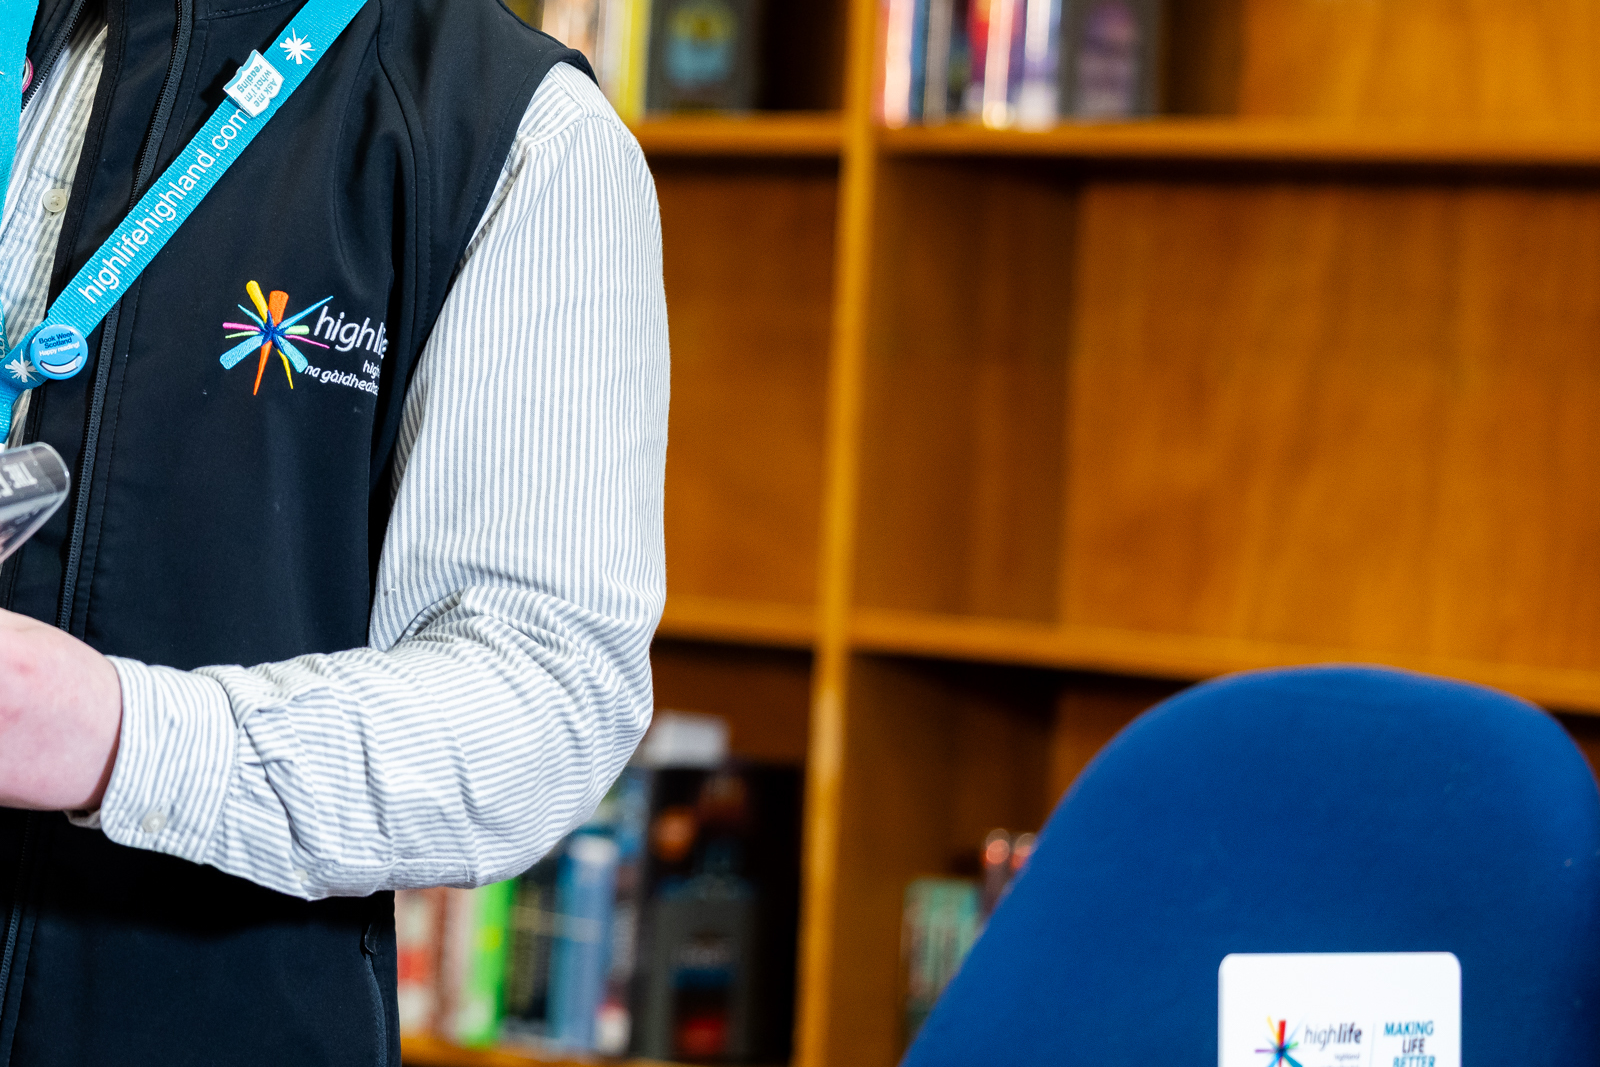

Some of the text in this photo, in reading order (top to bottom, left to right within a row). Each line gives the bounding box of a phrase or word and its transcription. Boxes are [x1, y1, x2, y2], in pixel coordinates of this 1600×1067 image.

[78, 108, 251, 304] highlifehighland.com
[39, 331, 74, 344] Book Week
[44, 337, 72, 349] Scotland
[305, 365, 321, 377] na
[3, 461, 38, 489] THE
[1384, 1021, 1434, 1036] MAKING
[1304, 1022, 1362, 1051] highlife
[1402, 1038, 1425, 1053] LIFE
[1393, 1055, 1436, 1067] BETTER
